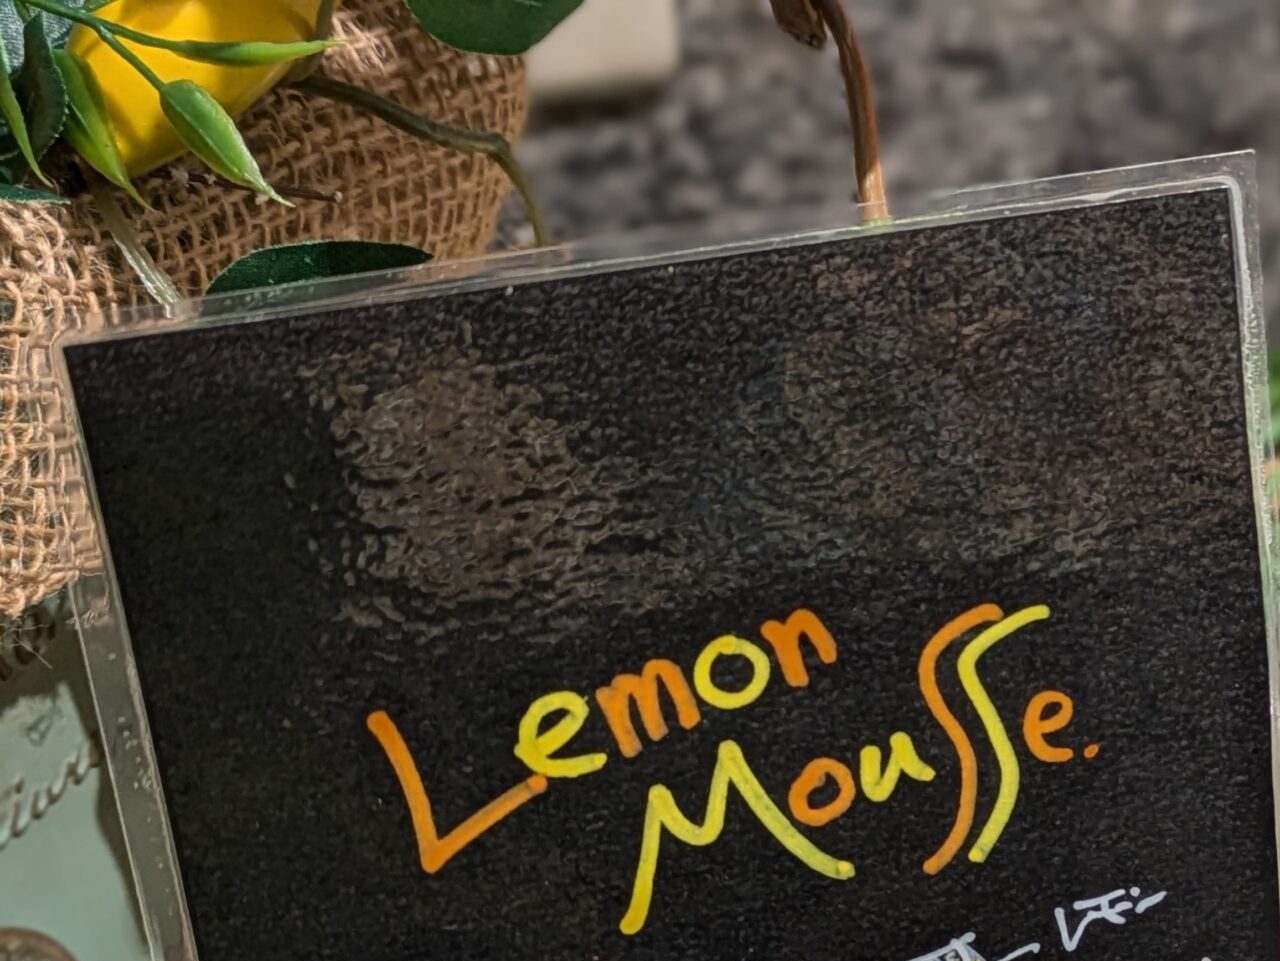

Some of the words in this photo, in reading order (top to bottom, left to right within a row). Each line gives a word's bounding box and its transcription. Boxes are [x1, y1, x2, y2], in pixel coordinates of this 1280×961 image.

[366, 607, 839, 875] Lemon
[1054, 886, 1168, 952] レモン
